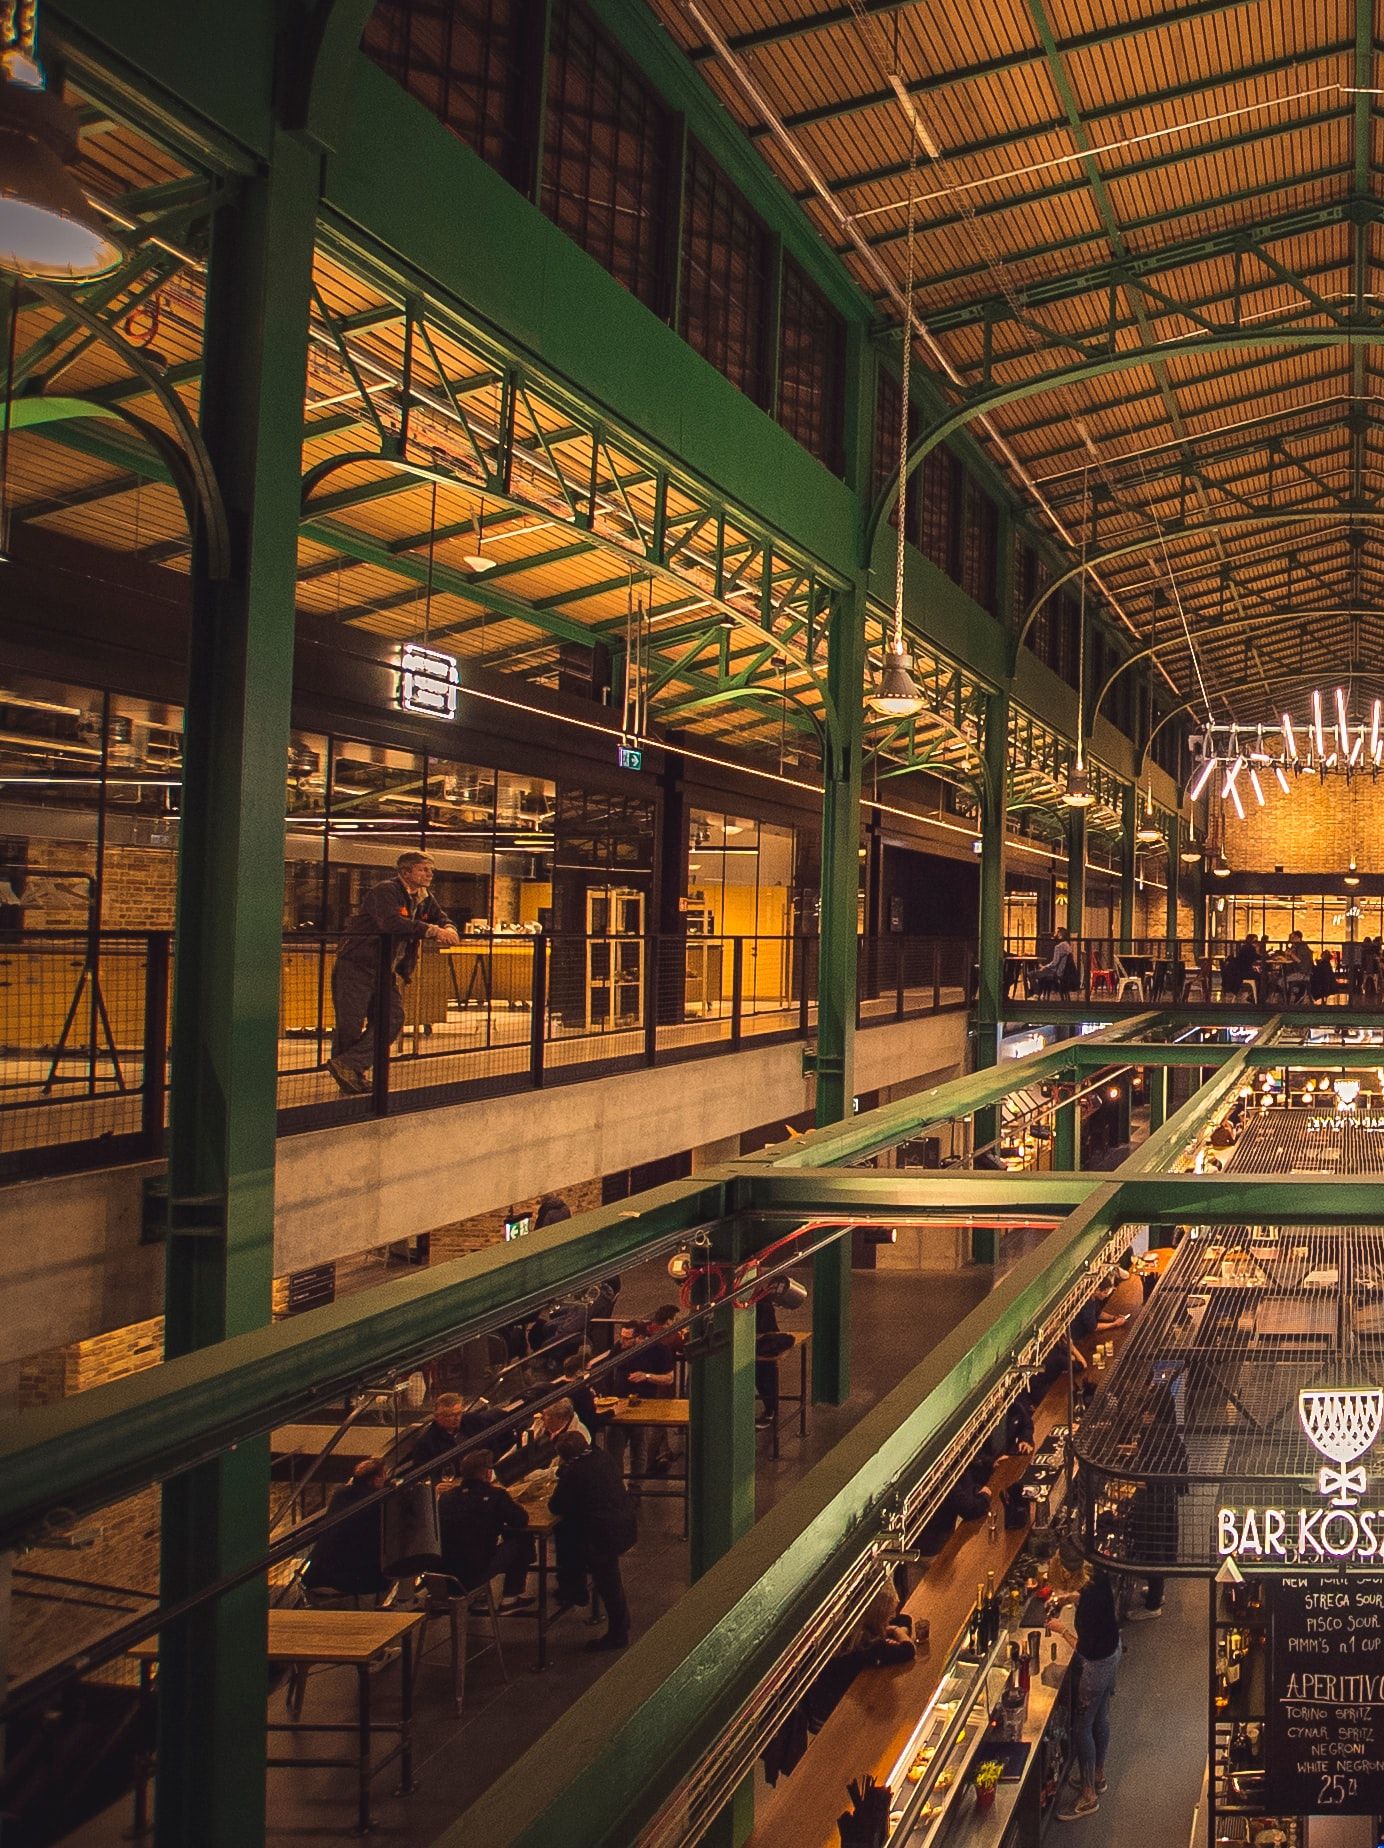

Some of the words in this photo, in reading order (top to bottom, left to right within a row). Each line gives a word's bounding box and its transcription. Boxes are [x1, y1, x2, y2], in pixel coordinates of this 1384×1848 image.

[1218, 1508, 1286, 1555] BAR
[1305, 1593, 1350, 1610] STREGA
[1355, 1593, 1384, 1609] SOUR
[1306, 1616, 1343, 1632] PISCO
[1347, 1614, 1380, 1632] SOUR
[1288, 1637, 1330, 1654] PIMM'S
[1361, 1637, 1382, 1652] CUP
[1286, 1705, 1328, 1720] TORINO
[1335, 1706, 1373, 1723] SPRITZ
[1287, 1726, 1329, 1740] CYNAR
[1338, 1727, 1375, 1742] SPRITZ
[1311, 1742, 1366, 1757] NEGRONI
[1296, 1760, 1329, 1774] WHITE
